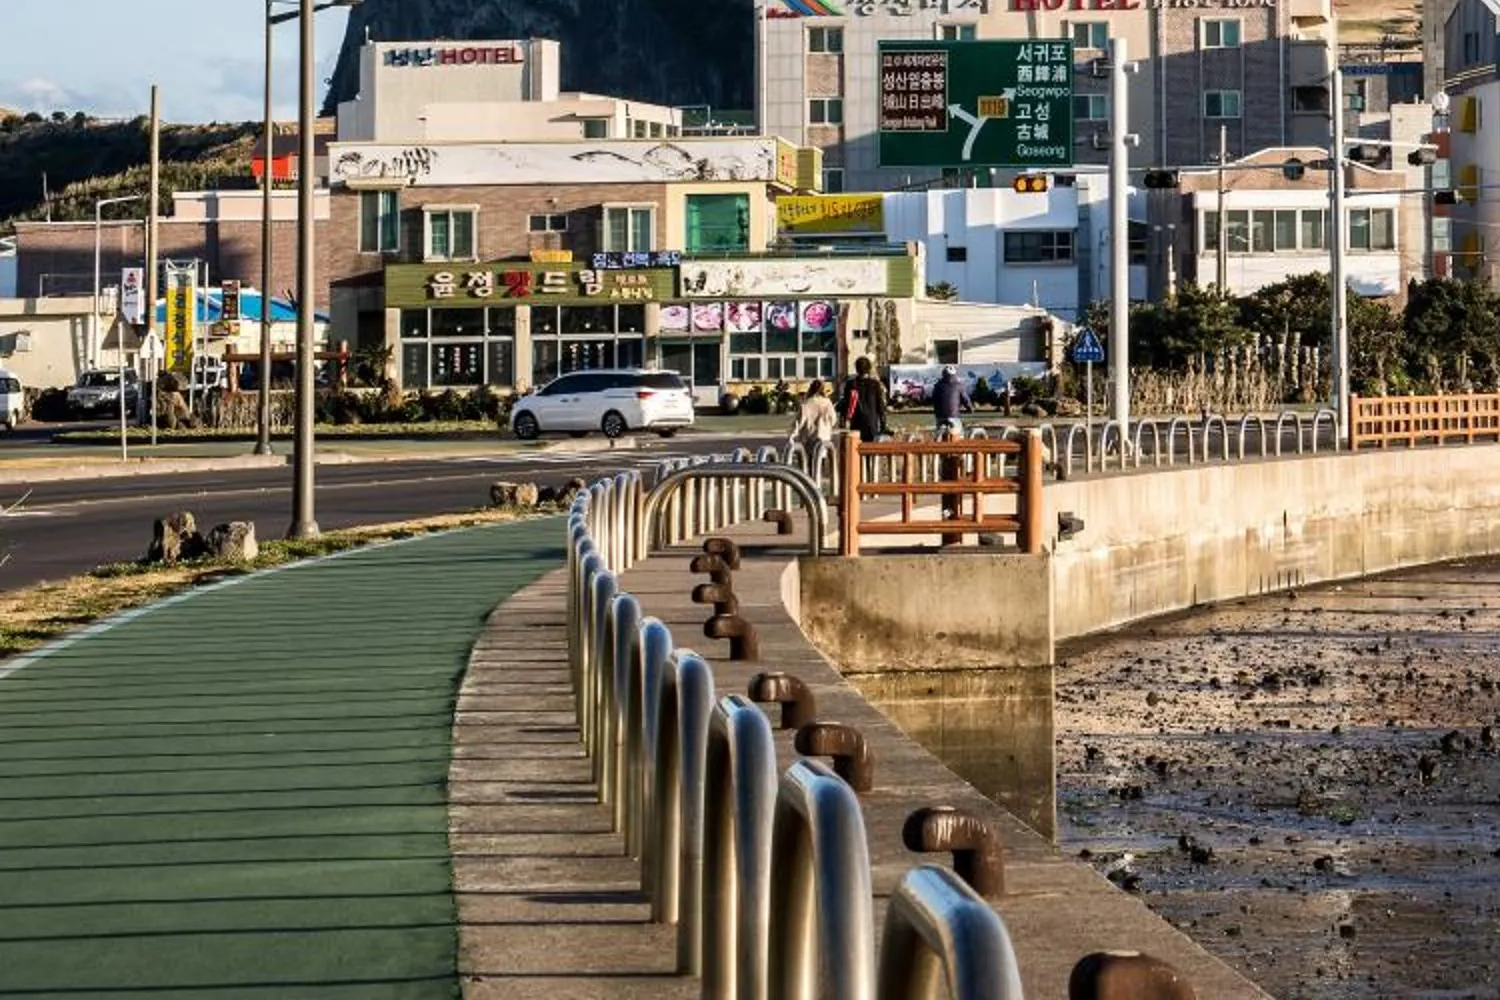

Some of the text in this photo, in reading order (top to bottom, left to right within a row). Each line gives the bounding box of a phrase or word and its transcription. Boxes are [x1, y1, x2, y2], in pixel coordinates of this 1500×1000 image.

[440, 47, 524, 64] HOTEL
[1016, 44, 1067, 62] 서귀포
[883, 71, 945, 91] 성산일출봉
